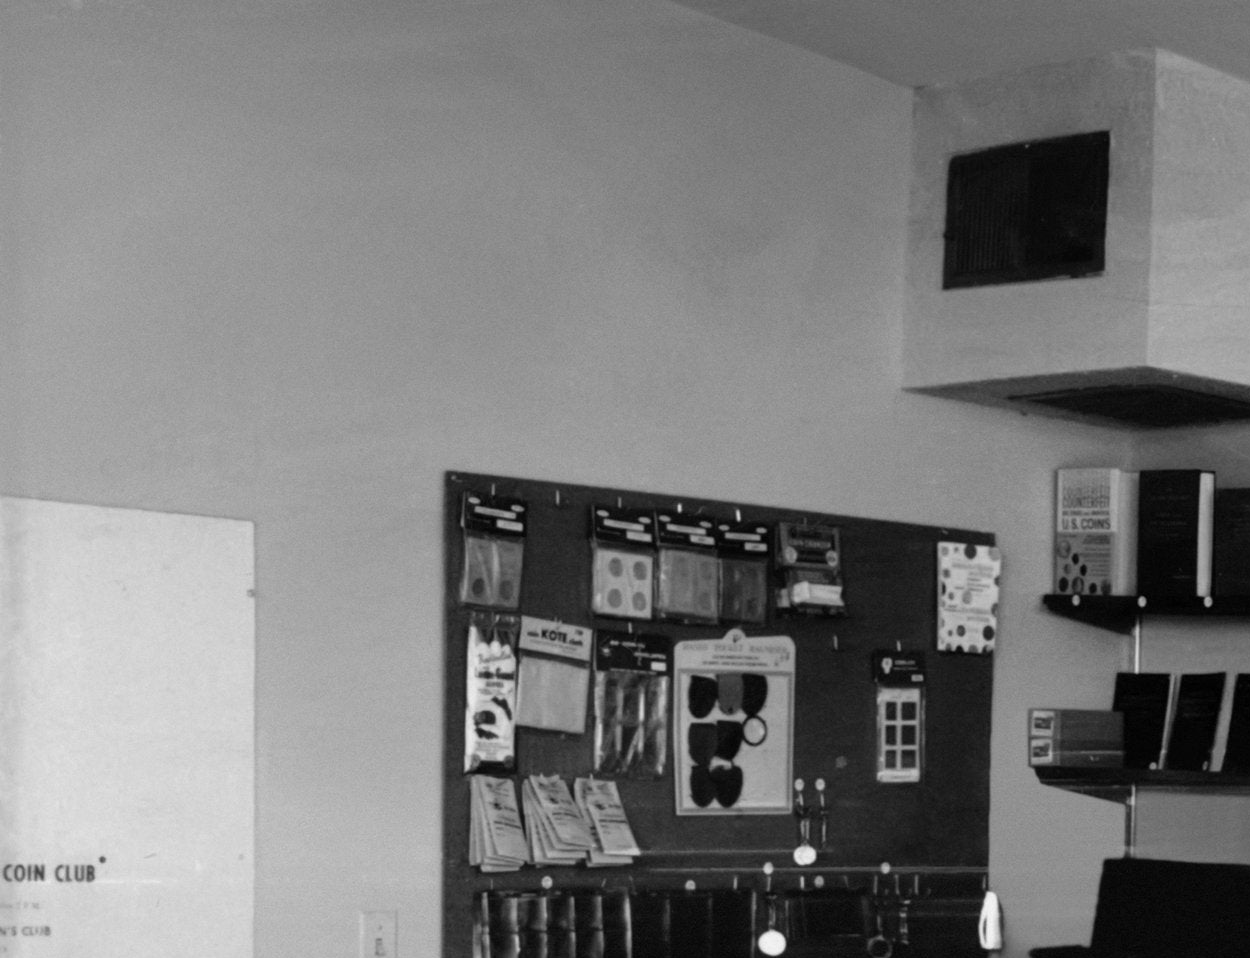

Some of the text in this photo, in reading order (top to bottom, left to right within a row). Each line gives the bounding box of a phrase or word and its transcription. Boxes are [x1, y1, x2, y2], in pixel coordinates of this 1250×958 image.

[1081, 517, 1111, 530] COINS
[3, 864, 96, 882] COIN CLUB
[21, 926, 51, 936] CLUB
